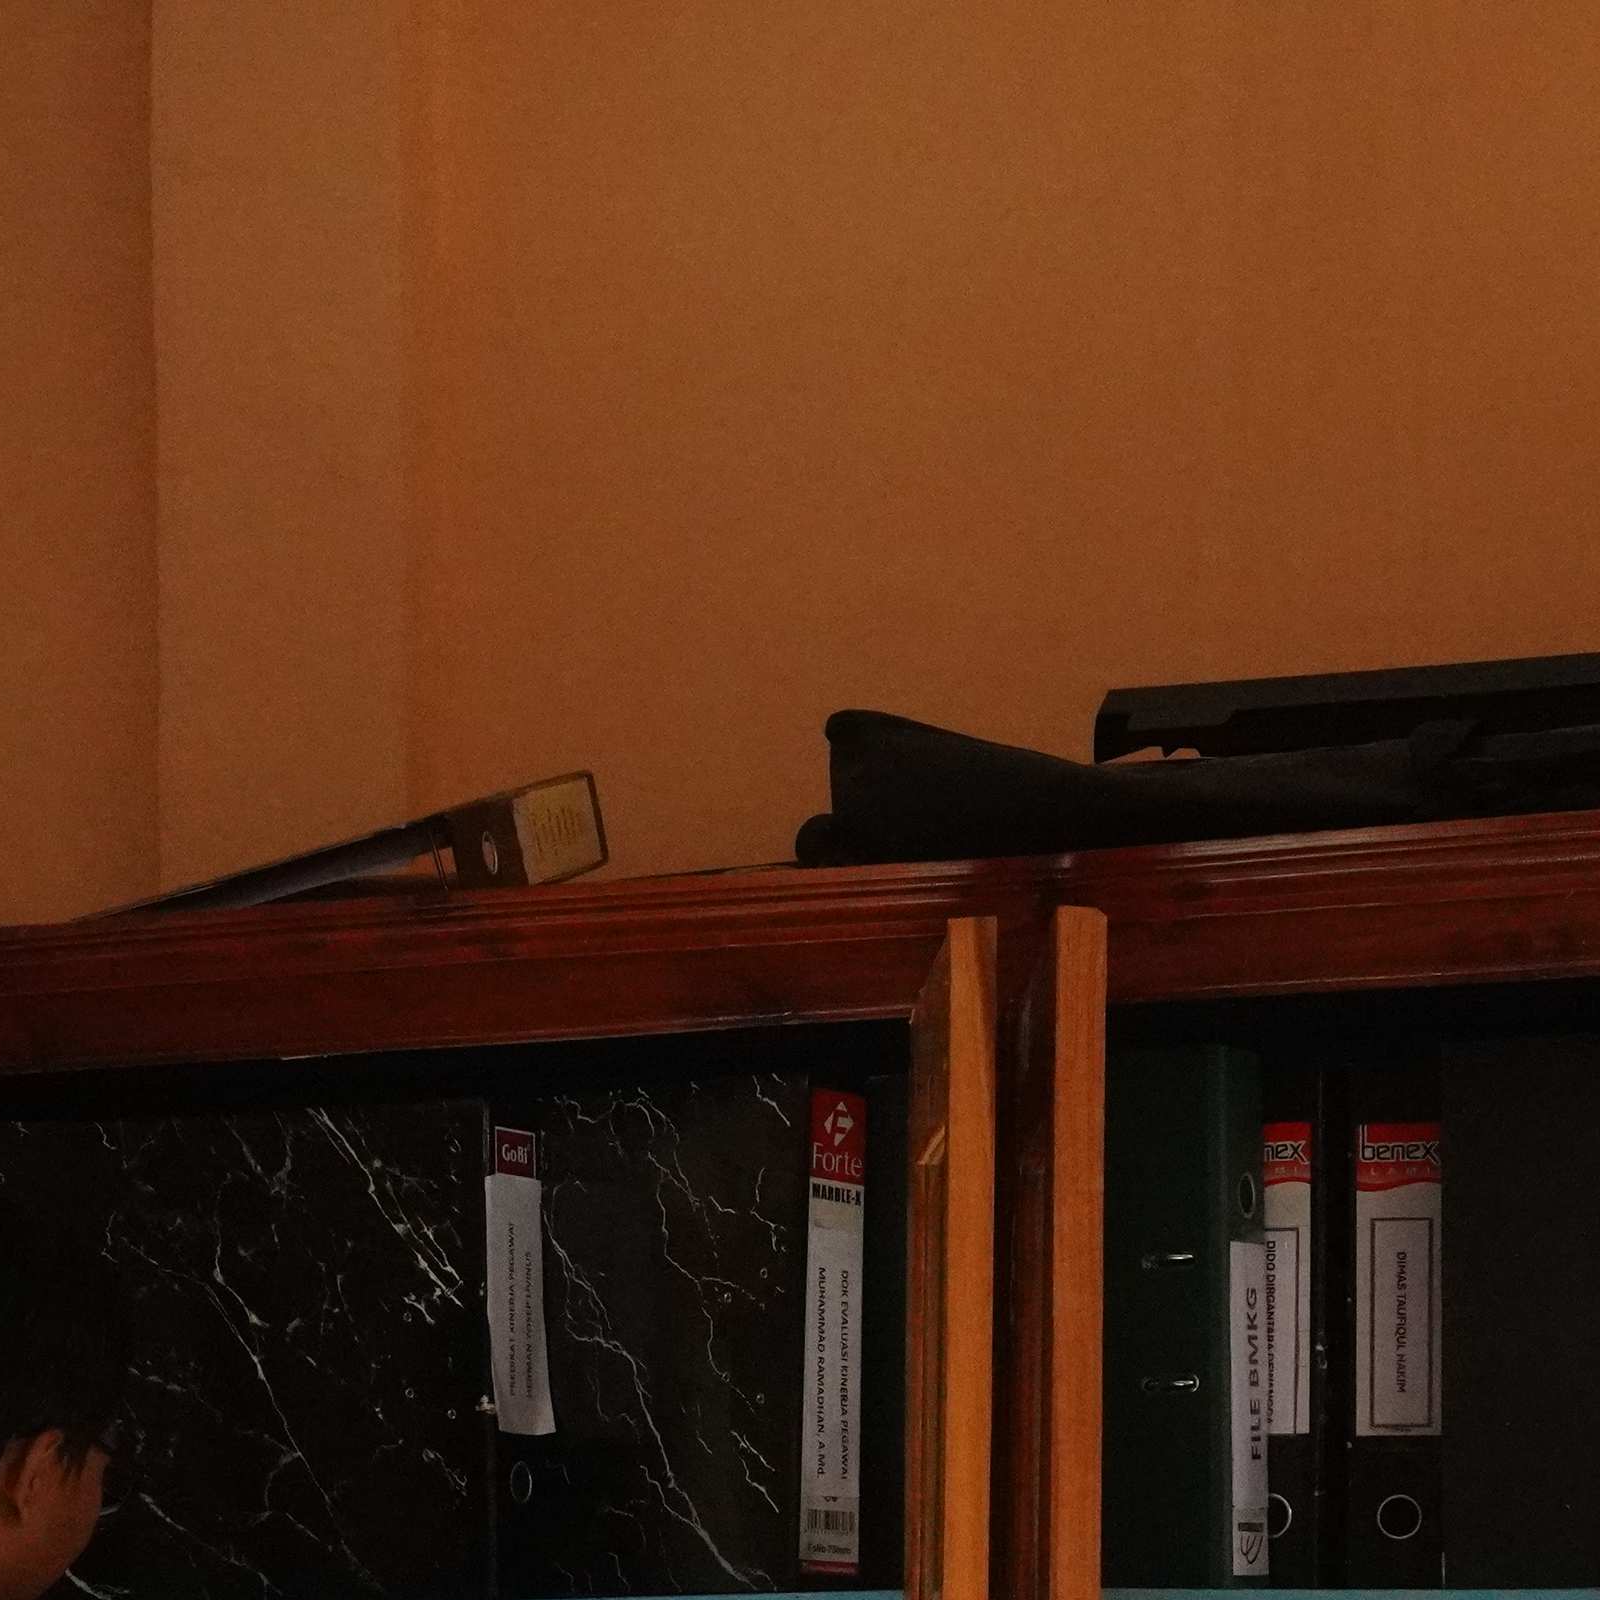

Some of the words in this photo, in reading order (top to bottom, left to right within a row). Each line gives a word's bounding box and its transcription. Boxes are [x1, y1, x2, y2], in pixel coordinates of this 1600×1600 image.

[812, 1141, 864, 1178] Forte
[1264, 1140, 1311, 1165] nex
[1360, 1124, 1441, 1166] benex
[812, 1183, 862, 1206] MARBLE-X
[1266, 1240, 1276, 1271] DIDO
[1396, 1252, 1406, 1290] DIMAS
[840, 1269, 849, 1298] DOK
[817, 1267, 826, 1353] MUHAMMAD
[840, 1301, 849, 1362] EVALUASI
[1246, 1287, 1260, 1387] BMKG
[840, 1365, 849, 1416] KINERJA
[1396, 1353, 1406, 1393] HAKIM
[840, 1420, 849, 1480] PEGAWAI
[1250, 1400, 1261, 1460] FILE
